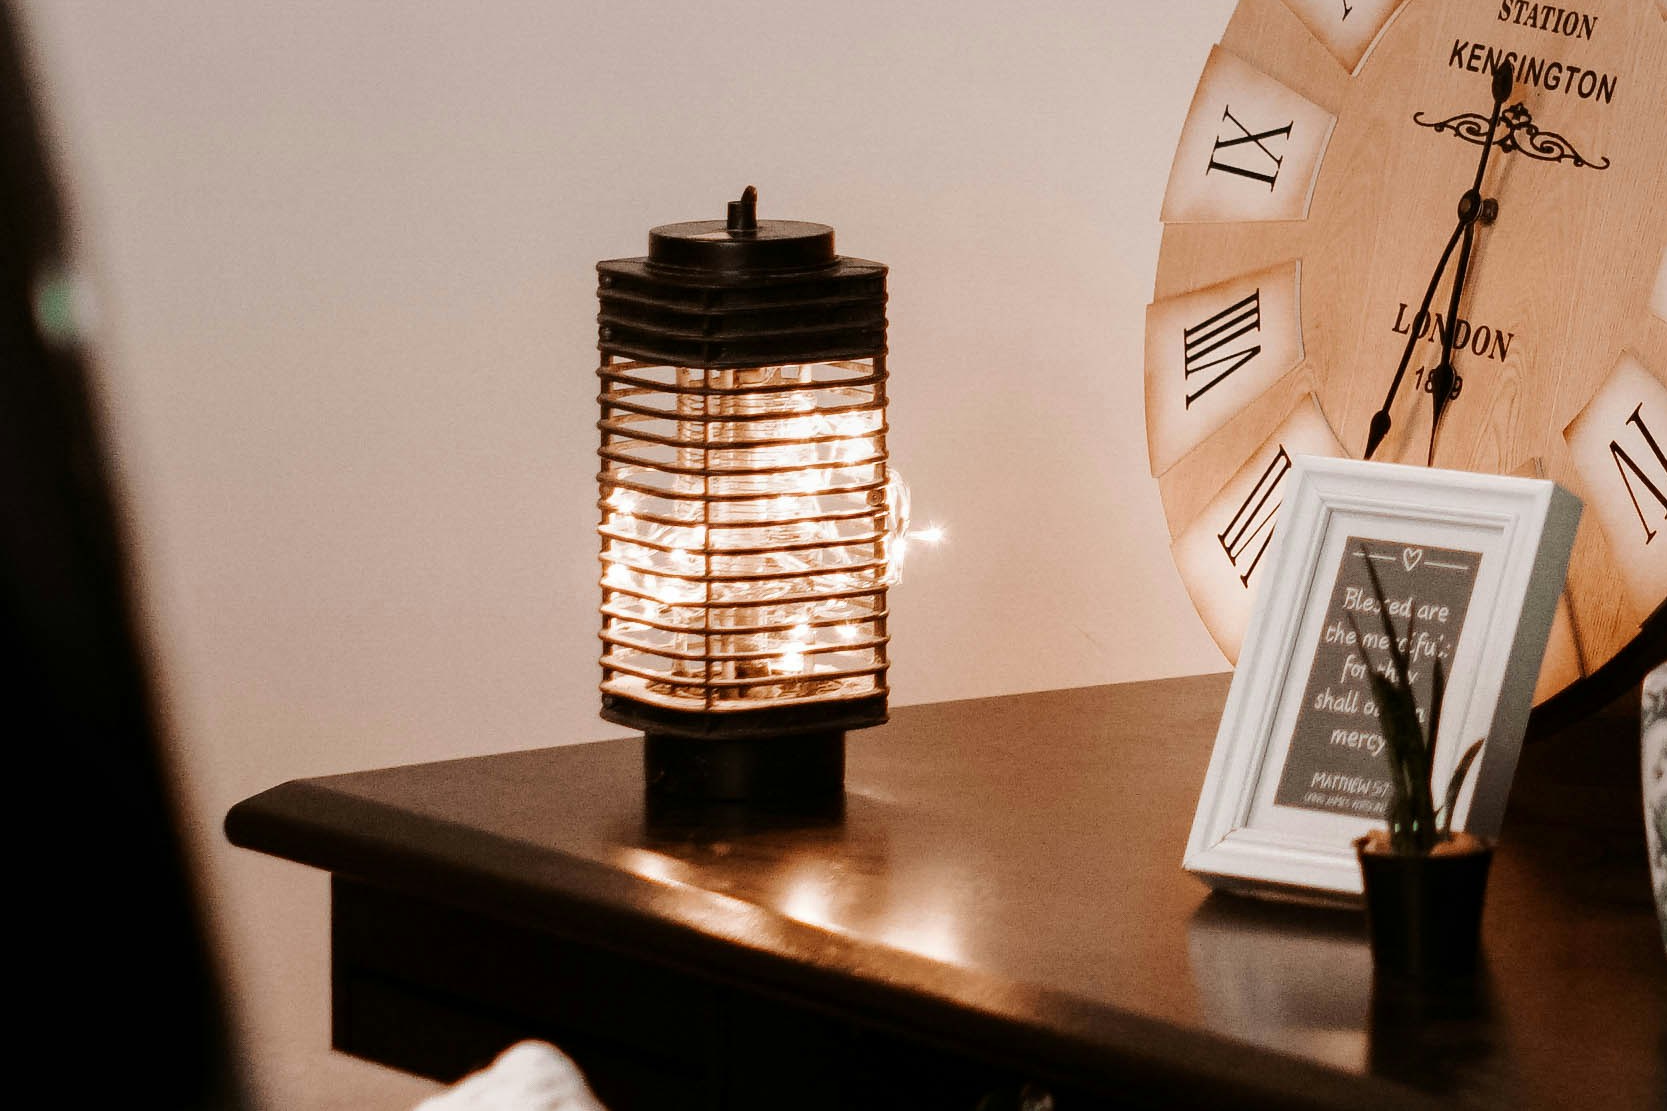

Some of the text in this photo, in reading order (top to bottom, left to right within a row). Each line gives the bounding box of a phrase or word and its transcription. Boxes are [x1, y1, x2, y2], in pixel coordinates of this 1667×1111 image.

[1449, 39, 1617, 104] KENSINGTON
[1206, 105, 1294, 192] IX
[1184, 288, 1262, 410] VIII
[1392, 303, 1514, 363] LONDON
[1325, 621, 1357, 644] the
[1417, 604, 1449, 623] are
[1314, 687, 1359, 713] shall
